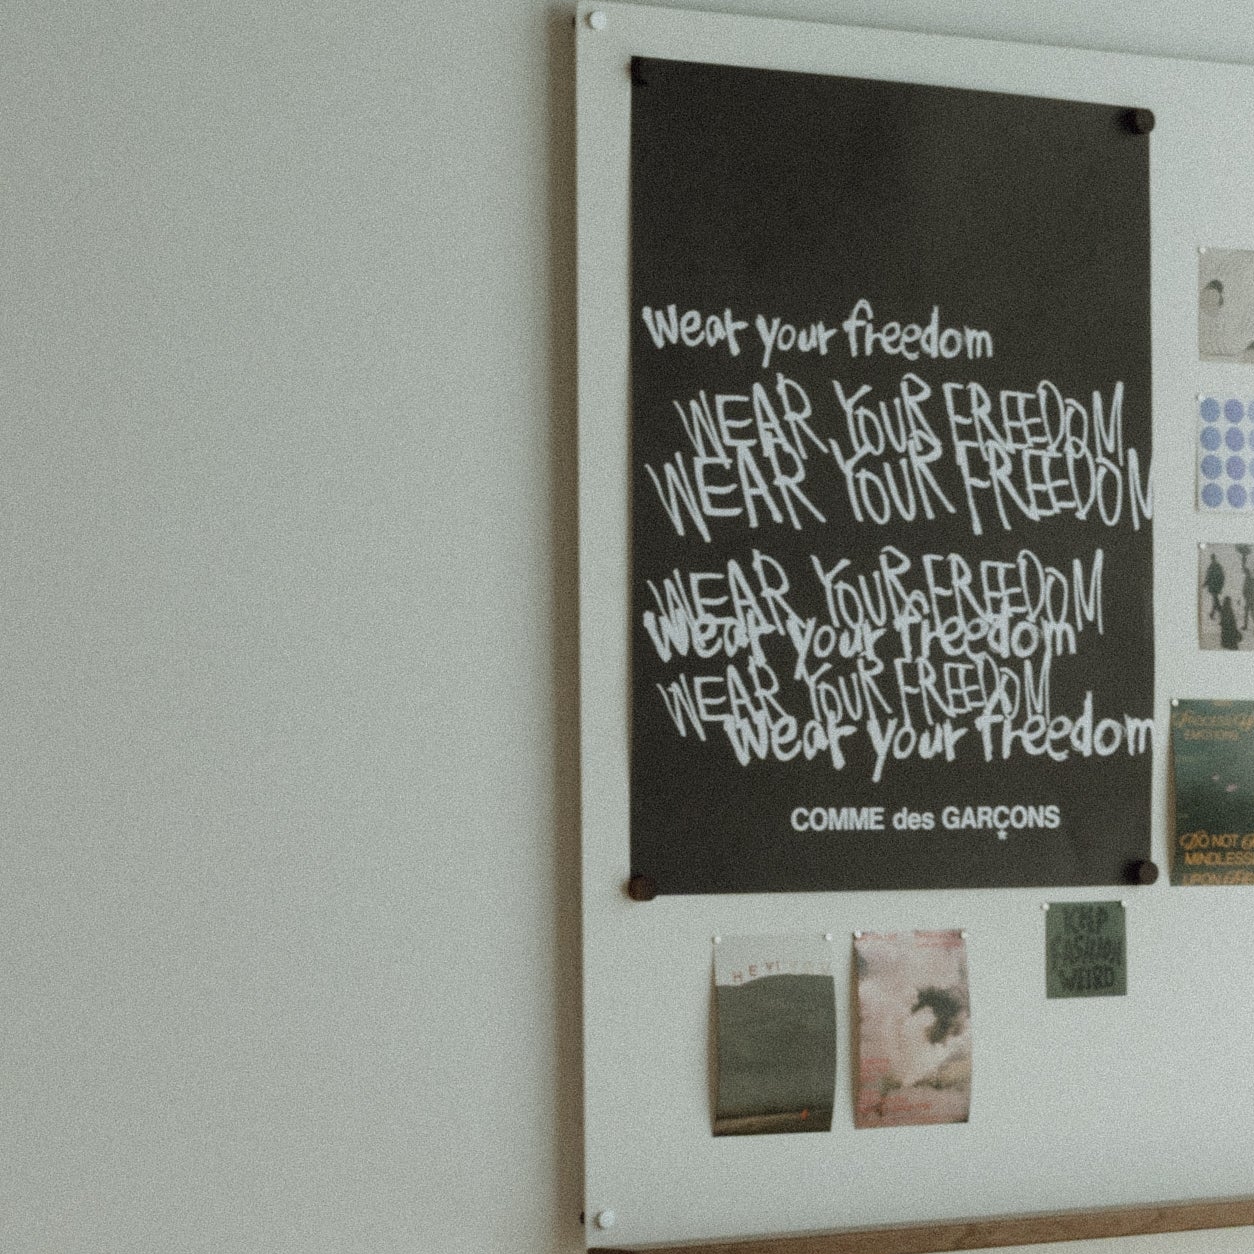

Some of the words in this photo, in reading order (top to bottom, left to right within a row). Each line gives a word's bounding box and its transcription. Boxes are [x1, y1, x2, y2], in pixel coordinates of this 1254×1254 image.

[756, 312, 838, 368] your
[842, 298, 994, 360] freedom
[673, 373, 829, 469] WEAR
[832, 373, 943, 456] YOUR
[942, 379, 1124, 466] FREEDOM
[645, 430, 827, 543] WEAR
[828, 430, 957, 525] YOUR
[646, 548, 800, 636] WEAR
[810, 545, 921, 630] YOUR
[922, 548, 1104, 635] FREEDOM
[893, 588, 1077, 660] freedom
[865, 714, 971, 783] your
[975, 690, 1155, 762] freedom
[790, 807, 885, 832] COMME
[892, 809, 935, 831] des
[941, 804, 1061, 841] GARÇONS
[1211, 833, 1239, 848] NOT
